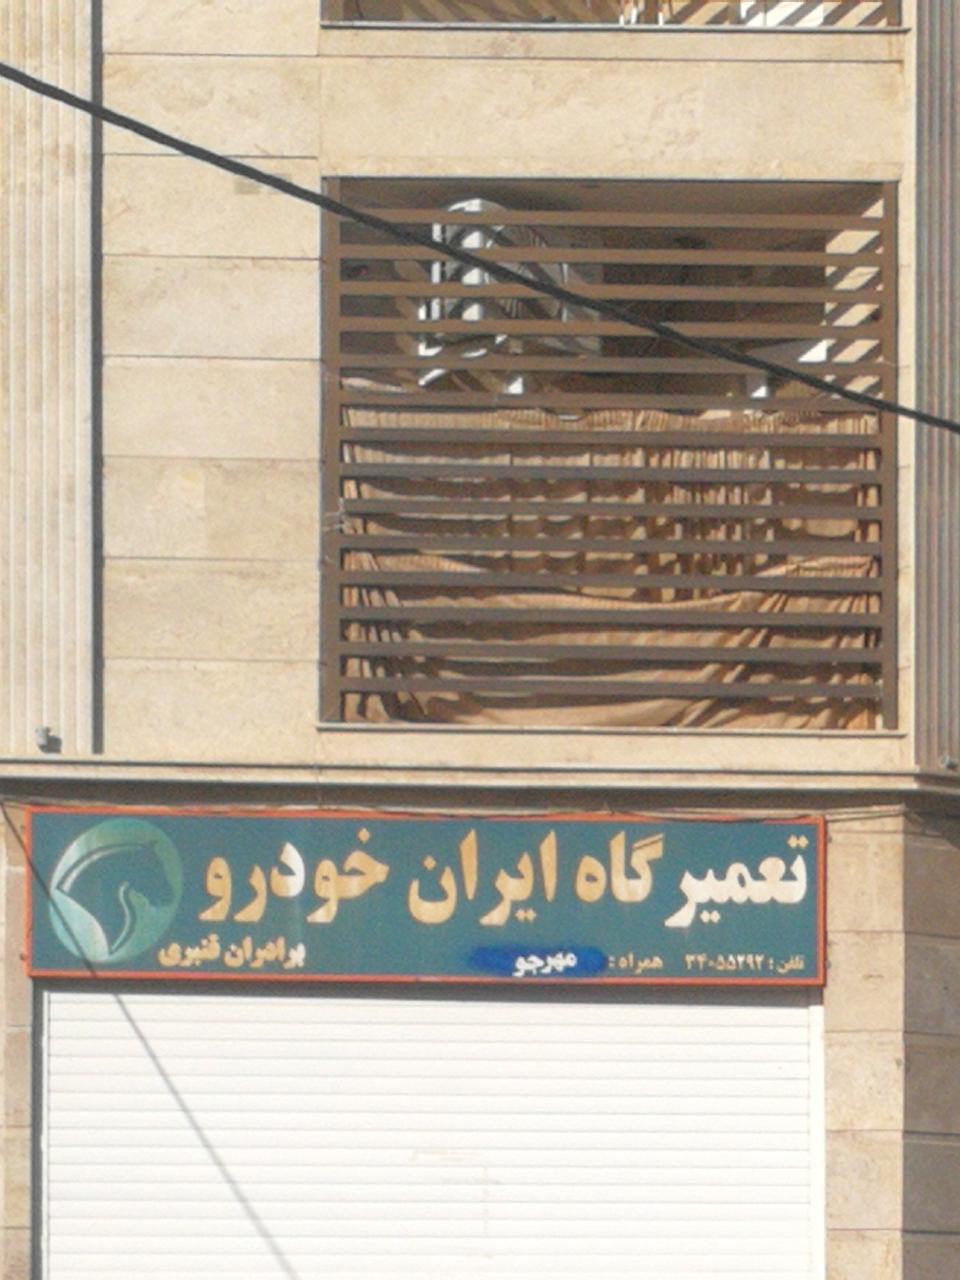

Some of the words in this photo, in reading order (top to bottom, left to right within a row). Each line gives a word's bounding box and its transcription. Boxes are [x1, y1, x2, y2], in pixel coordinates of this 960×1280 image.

[197, 826, 390, 924] خودرو
[408, 828, 557, 927] ایران
[157, 933, 221, 967] قنبری
[223, 935, 306, 969] برادران
[511, 951, 578, 978] مهرجو
